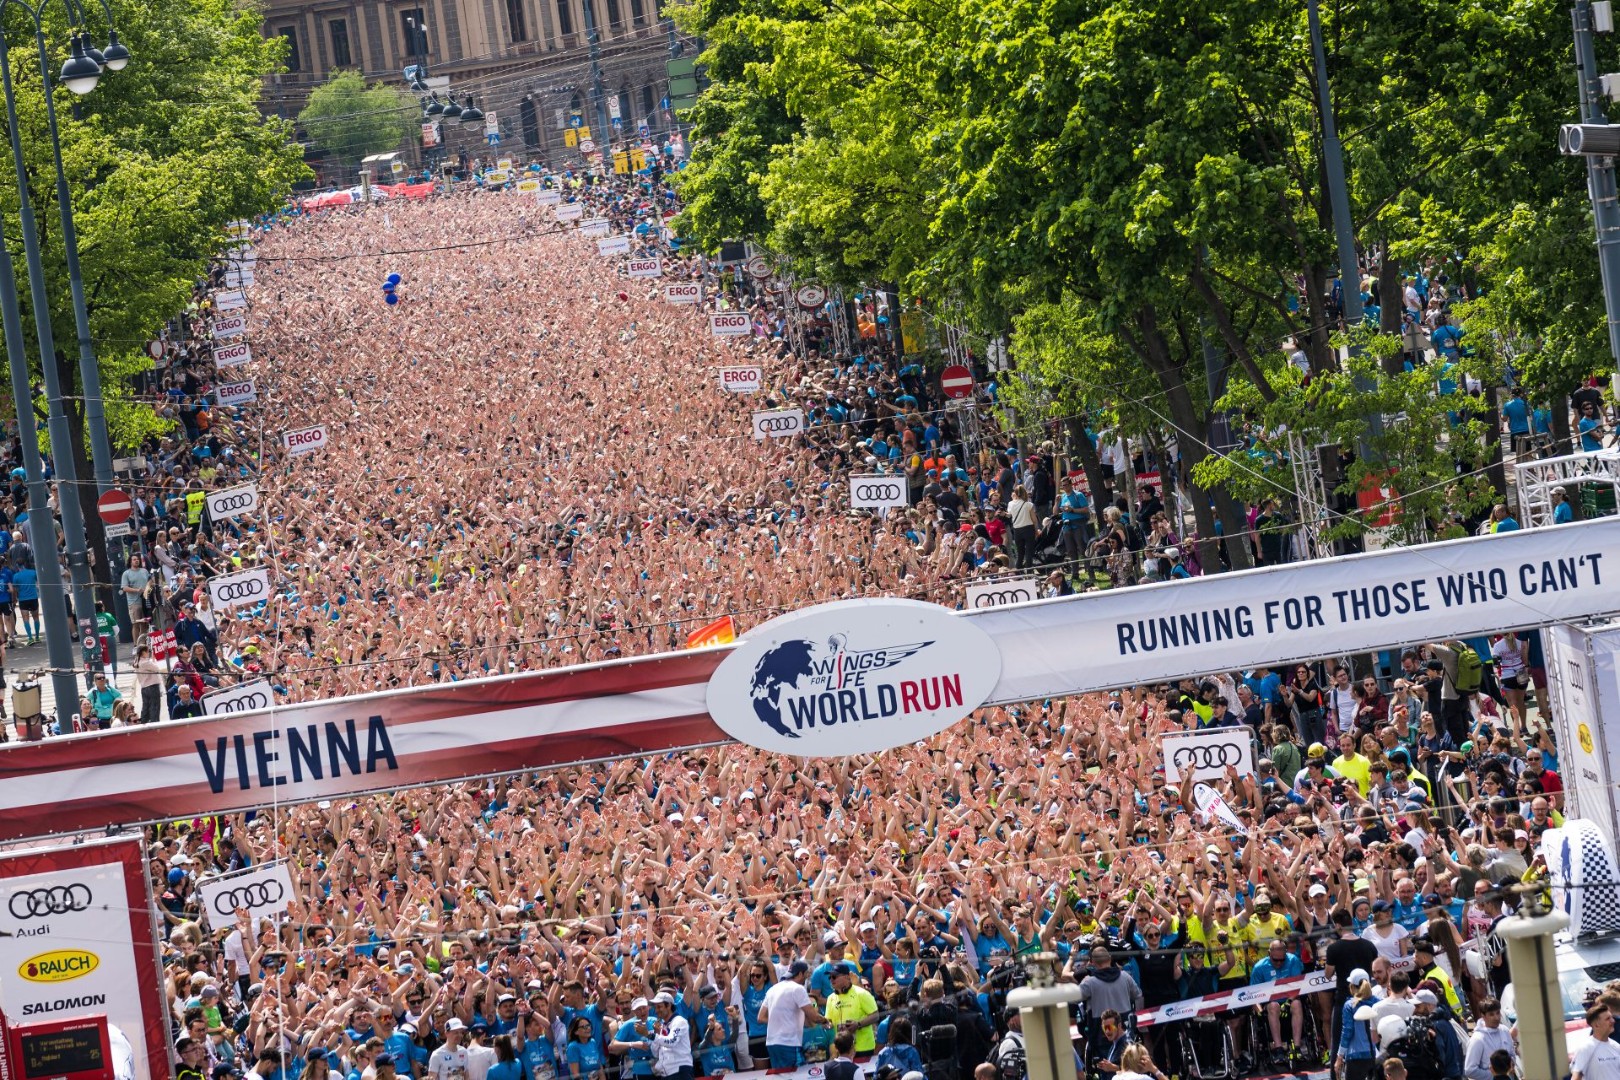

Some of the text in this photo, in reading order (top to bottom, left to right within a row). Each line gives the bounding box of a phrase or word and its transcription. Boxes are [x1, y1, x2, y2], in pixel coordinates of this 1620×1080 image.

[631, 261, 657, 272] ERGO
[669, 286, 698, 296] ERGO
[216, 318, 242, 332] ERGO
[714, 316, 746, 327] ERGO
[217, 346, 247, 361] ERGO
[723, 370, 757, 382] ERGO
[220, 383, 252, 398] ERGO
[287, 429, 323, 447] ERGO
[1116, 552, 1603, 656] RUNNING FOR THOSE WHO CAN'T
[810, 676, 826, 686] FOR
[194, 715, 399, 794] VIENNA
[16, 924, 51, 938] Audi
[39, 955, 90, 975] RAUCH
[22, 993, 106, 1016] SALOMON
